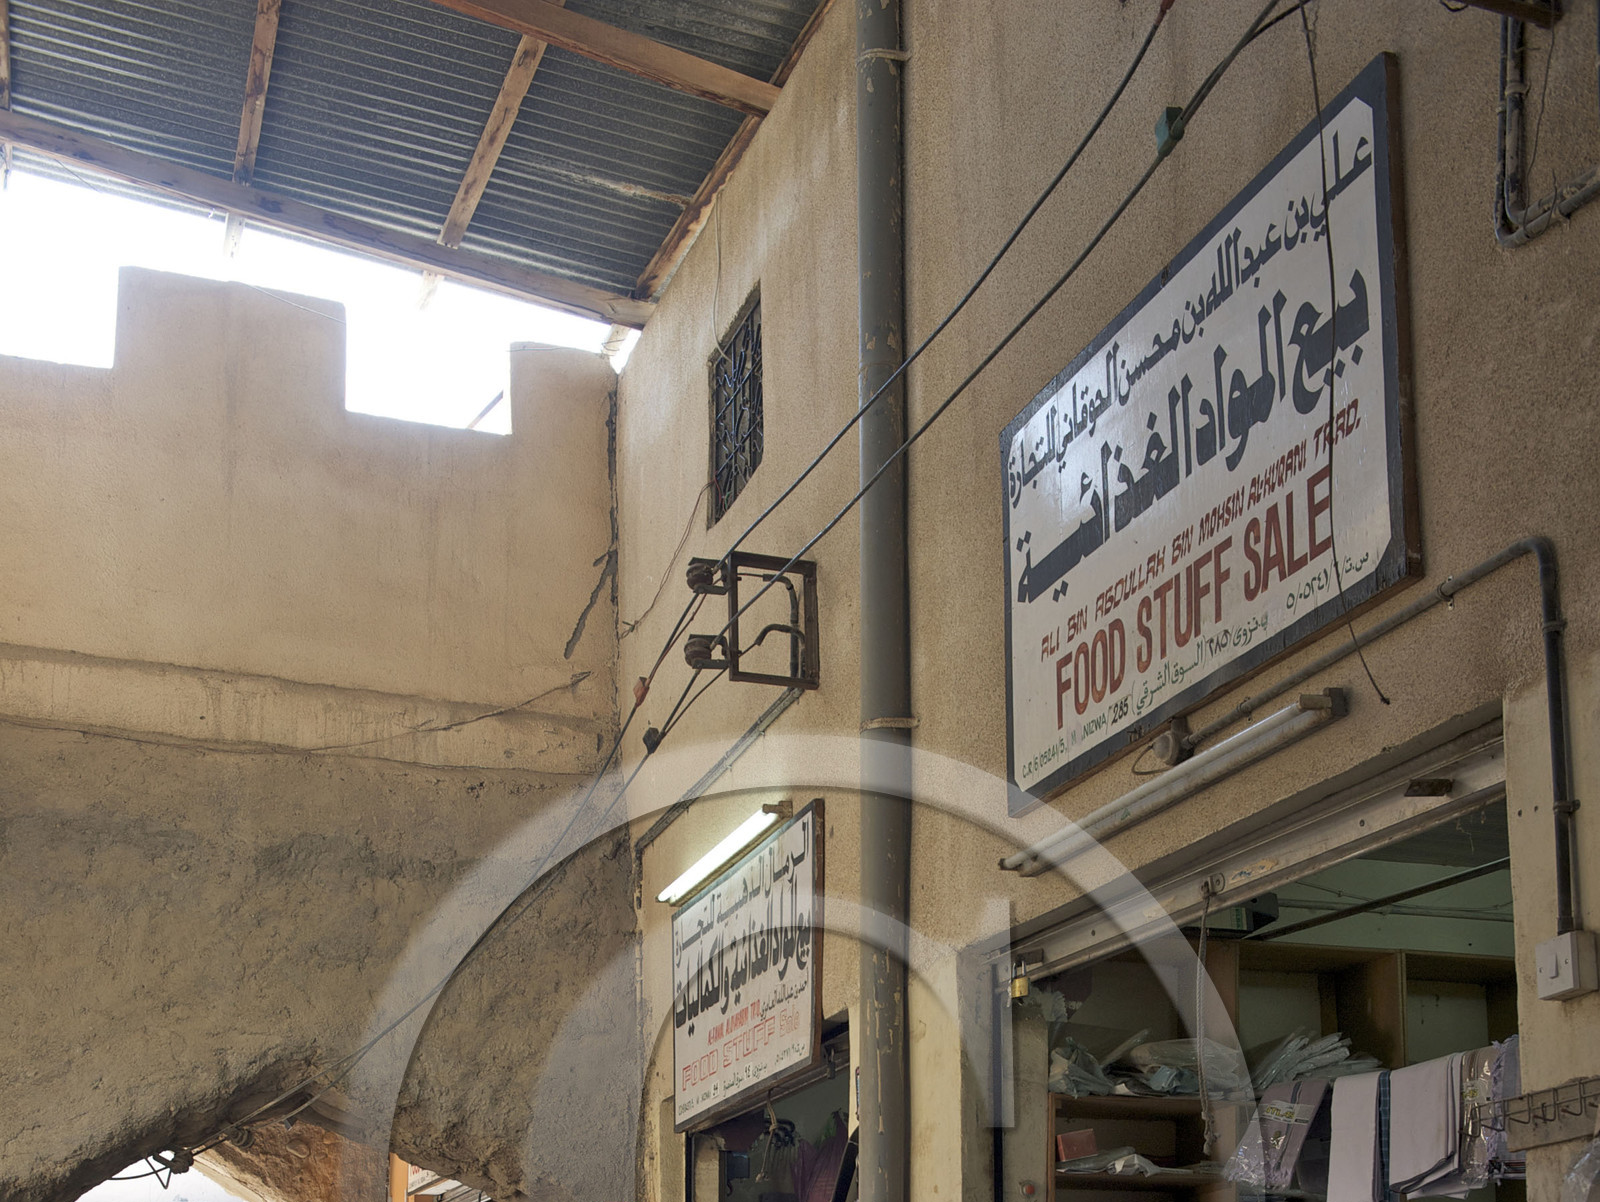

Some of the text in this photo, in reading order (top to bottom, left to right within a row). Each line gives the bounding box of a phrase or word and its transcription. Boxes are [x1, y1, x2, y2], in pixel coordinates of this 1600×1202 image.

[1284, 196, 1309, 251] بن
[1310, 130, 1372, 242] علي
[1119, 318, 1182, 406] محسن
[1182, 293, 1205, 344] بن
[1009, 405, 1057, 508] للتجارة
[1018, 269, 1370, 603] بيع المواد الغذائية
[1041, 626, 1060, 662] ALI
[1067, 605, 1088, 644] BIN
[1095, 546, 1166, 621] ABDULLAH
[1172, 524, 1194, 567] BIN
[1198, 485, 1244, 545] MOHSIN
[1056, 464, 1333, 730] FOOD STUFF SALE
[765, 821, 809, 897] الرمال
[675, 893, 715, 968] للتجارة
[675, 877, 810, 1037] بيع المواد الغذائية والكماليات
[682, 1049, 719, 1092] FOOD
[722, 1015, 777, 1068] STUFF
